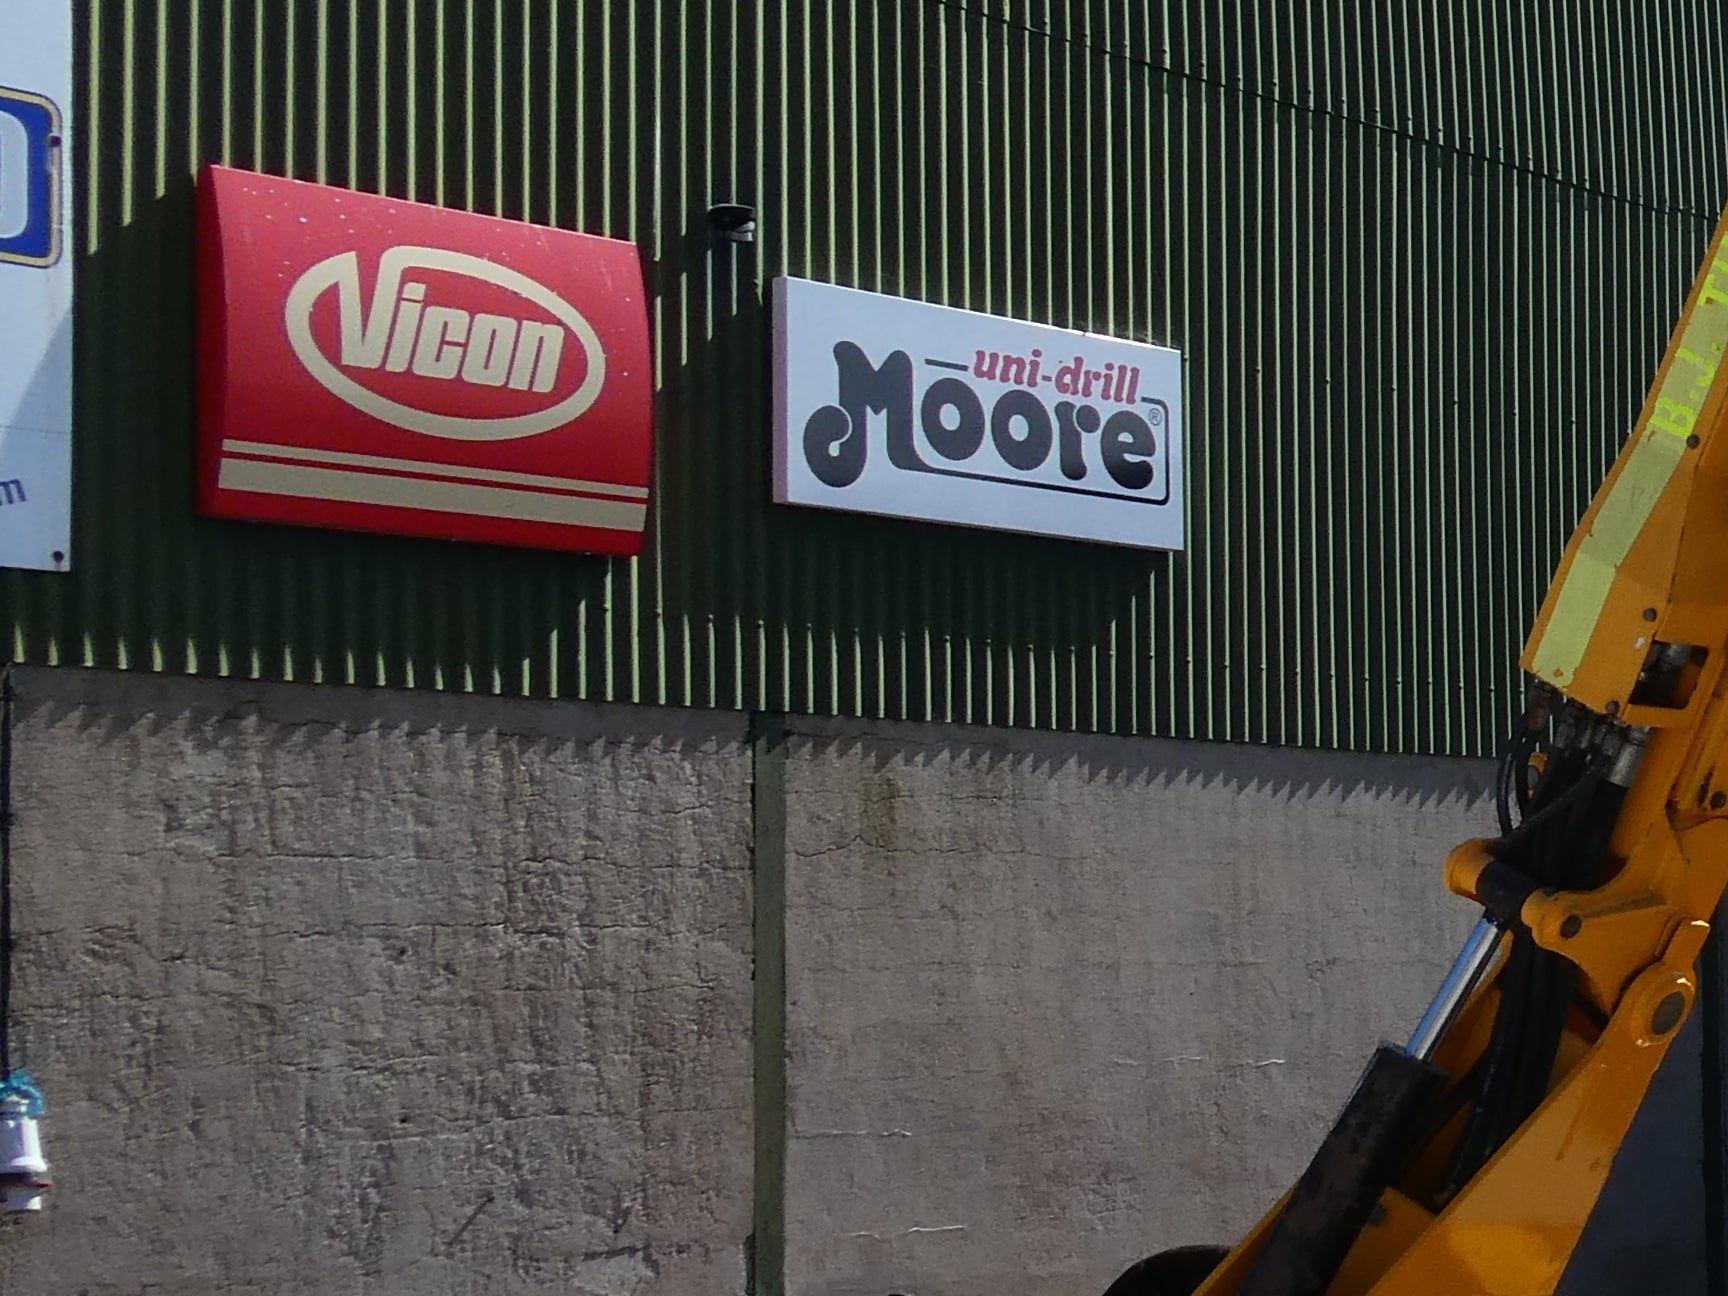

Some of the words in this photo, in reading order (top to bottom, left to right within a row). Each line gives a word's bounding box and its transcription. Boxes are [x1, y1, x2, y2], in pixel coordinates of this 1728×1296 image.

[338, 250, 565, 394] Vicon
[972, 349, 1140, 405] uni-drill
[803, 340, 1157, 490] Moore
